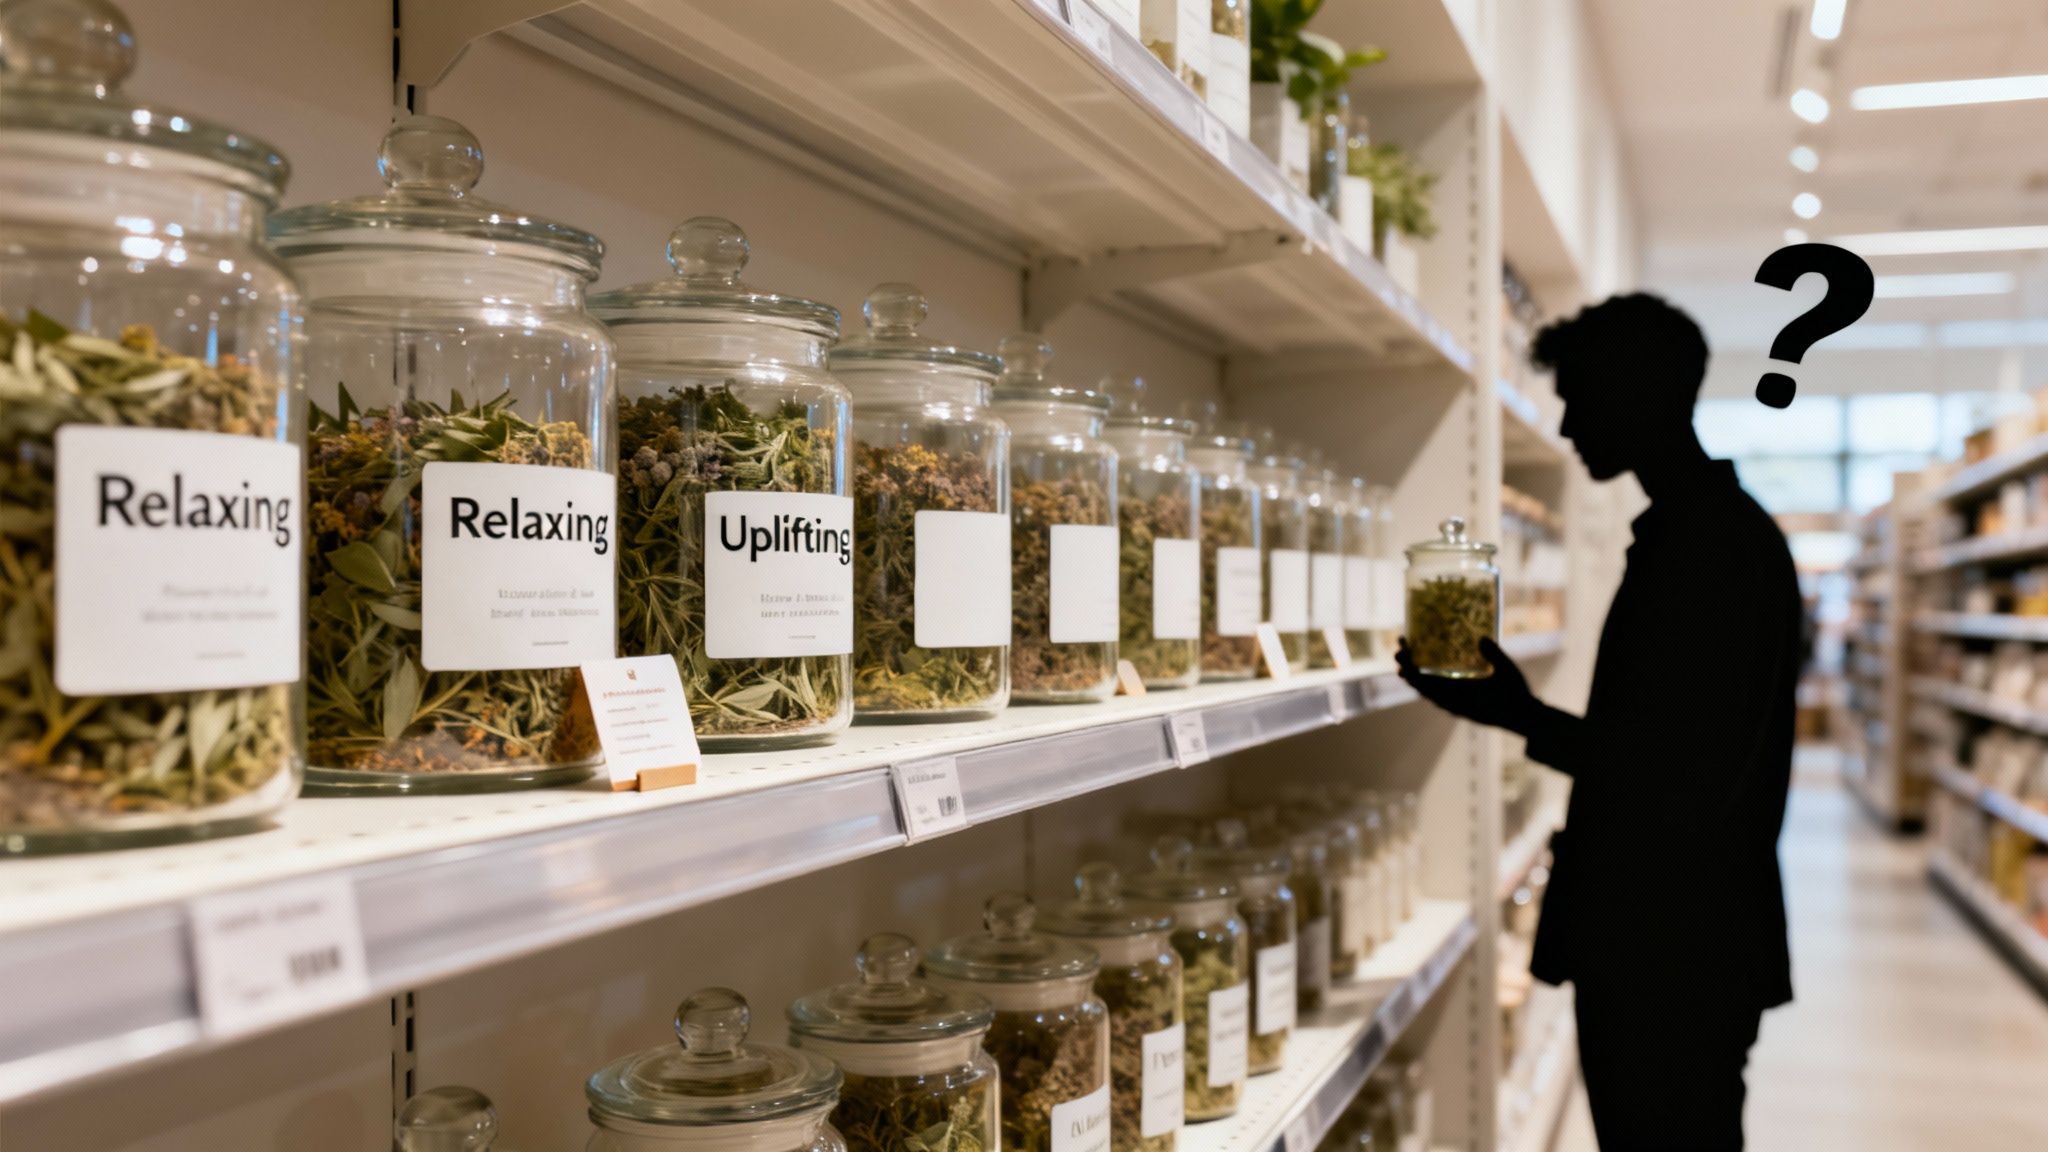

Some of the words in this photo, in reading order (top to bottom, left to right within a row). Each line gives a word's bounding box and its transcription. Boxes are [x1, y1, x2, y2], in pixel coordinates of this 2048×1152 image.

[97, 473, 292, 549] Relaxing
[450, 495, 610, 556] Relaxing
[720, 514, 852, 566] Uplifting
